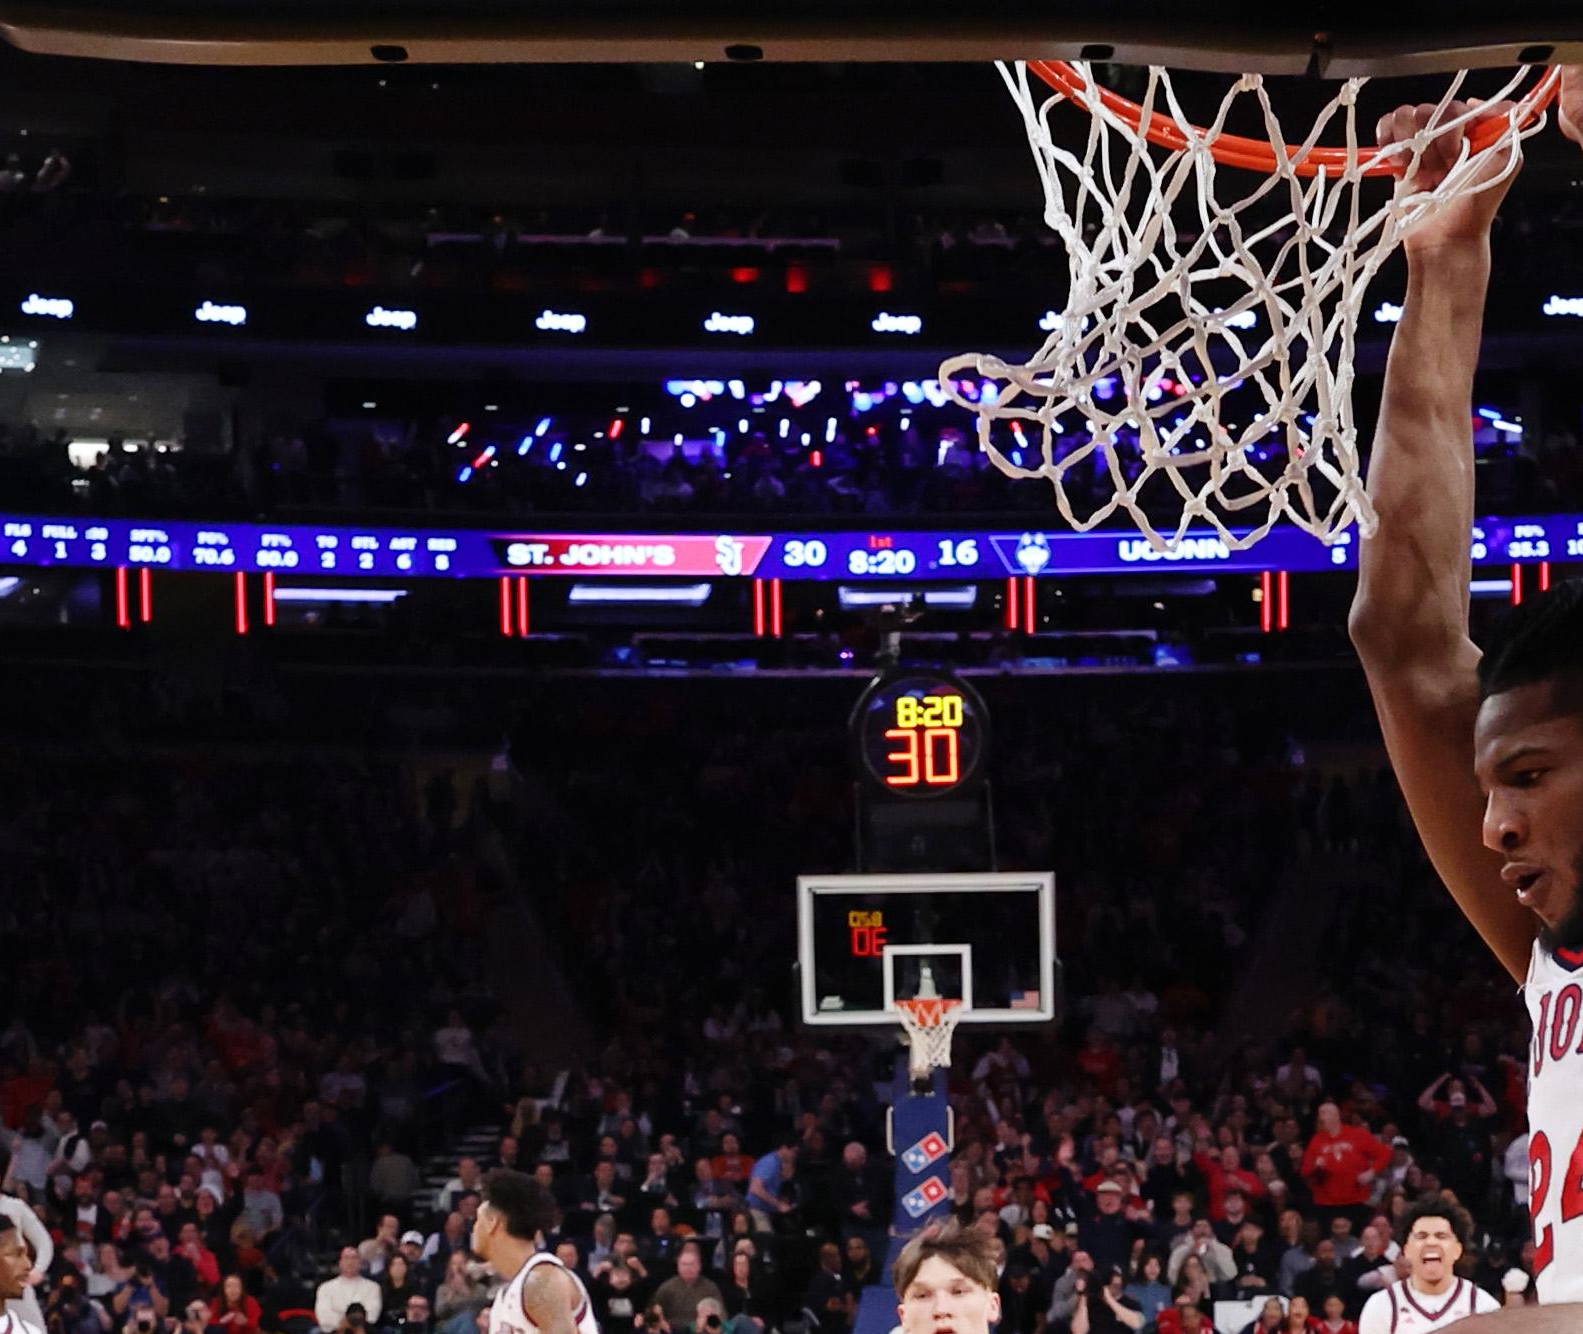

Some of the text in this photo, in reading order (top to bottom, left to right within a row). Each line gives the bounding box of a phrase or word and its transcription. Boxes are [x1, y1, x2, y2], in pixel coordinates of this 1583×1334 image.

[21, 294, 73, 318] Jeep
[195, 301, 247, 324] Jeep
[367, 306, 417, 329] Jeep
[535, 310, 586, 333] Jeep
[704, 311, 754, 334] Jeep
[872, 311, 922, 334] Jeep
[783, 540, 827, 567] 30
[870, 536, 892, 549] 1st
[937, 540, 979, 566] 16
[1118, 539, 1230, 561] UCONN
[1332, 548, 1346, 564] 5
[1508, 541, 1549, 558] 35.3
[11, 539, 28, 558] 4
[54, 542, 68, 559] 1
[91, 543, 106, 560] 3
[193, 548, 235, 565] 70.6
[321, 552, 336, 568] 2
[359, 552, 374, 569] 2
[396, 553, 412, 570] 6
[507, 543, 676, 566] ST. JOHN'S
[847, 549, 916, 575] 8:20
[896, 695, 964, 728] 8:20
[885, 729, 958, 784] 30
